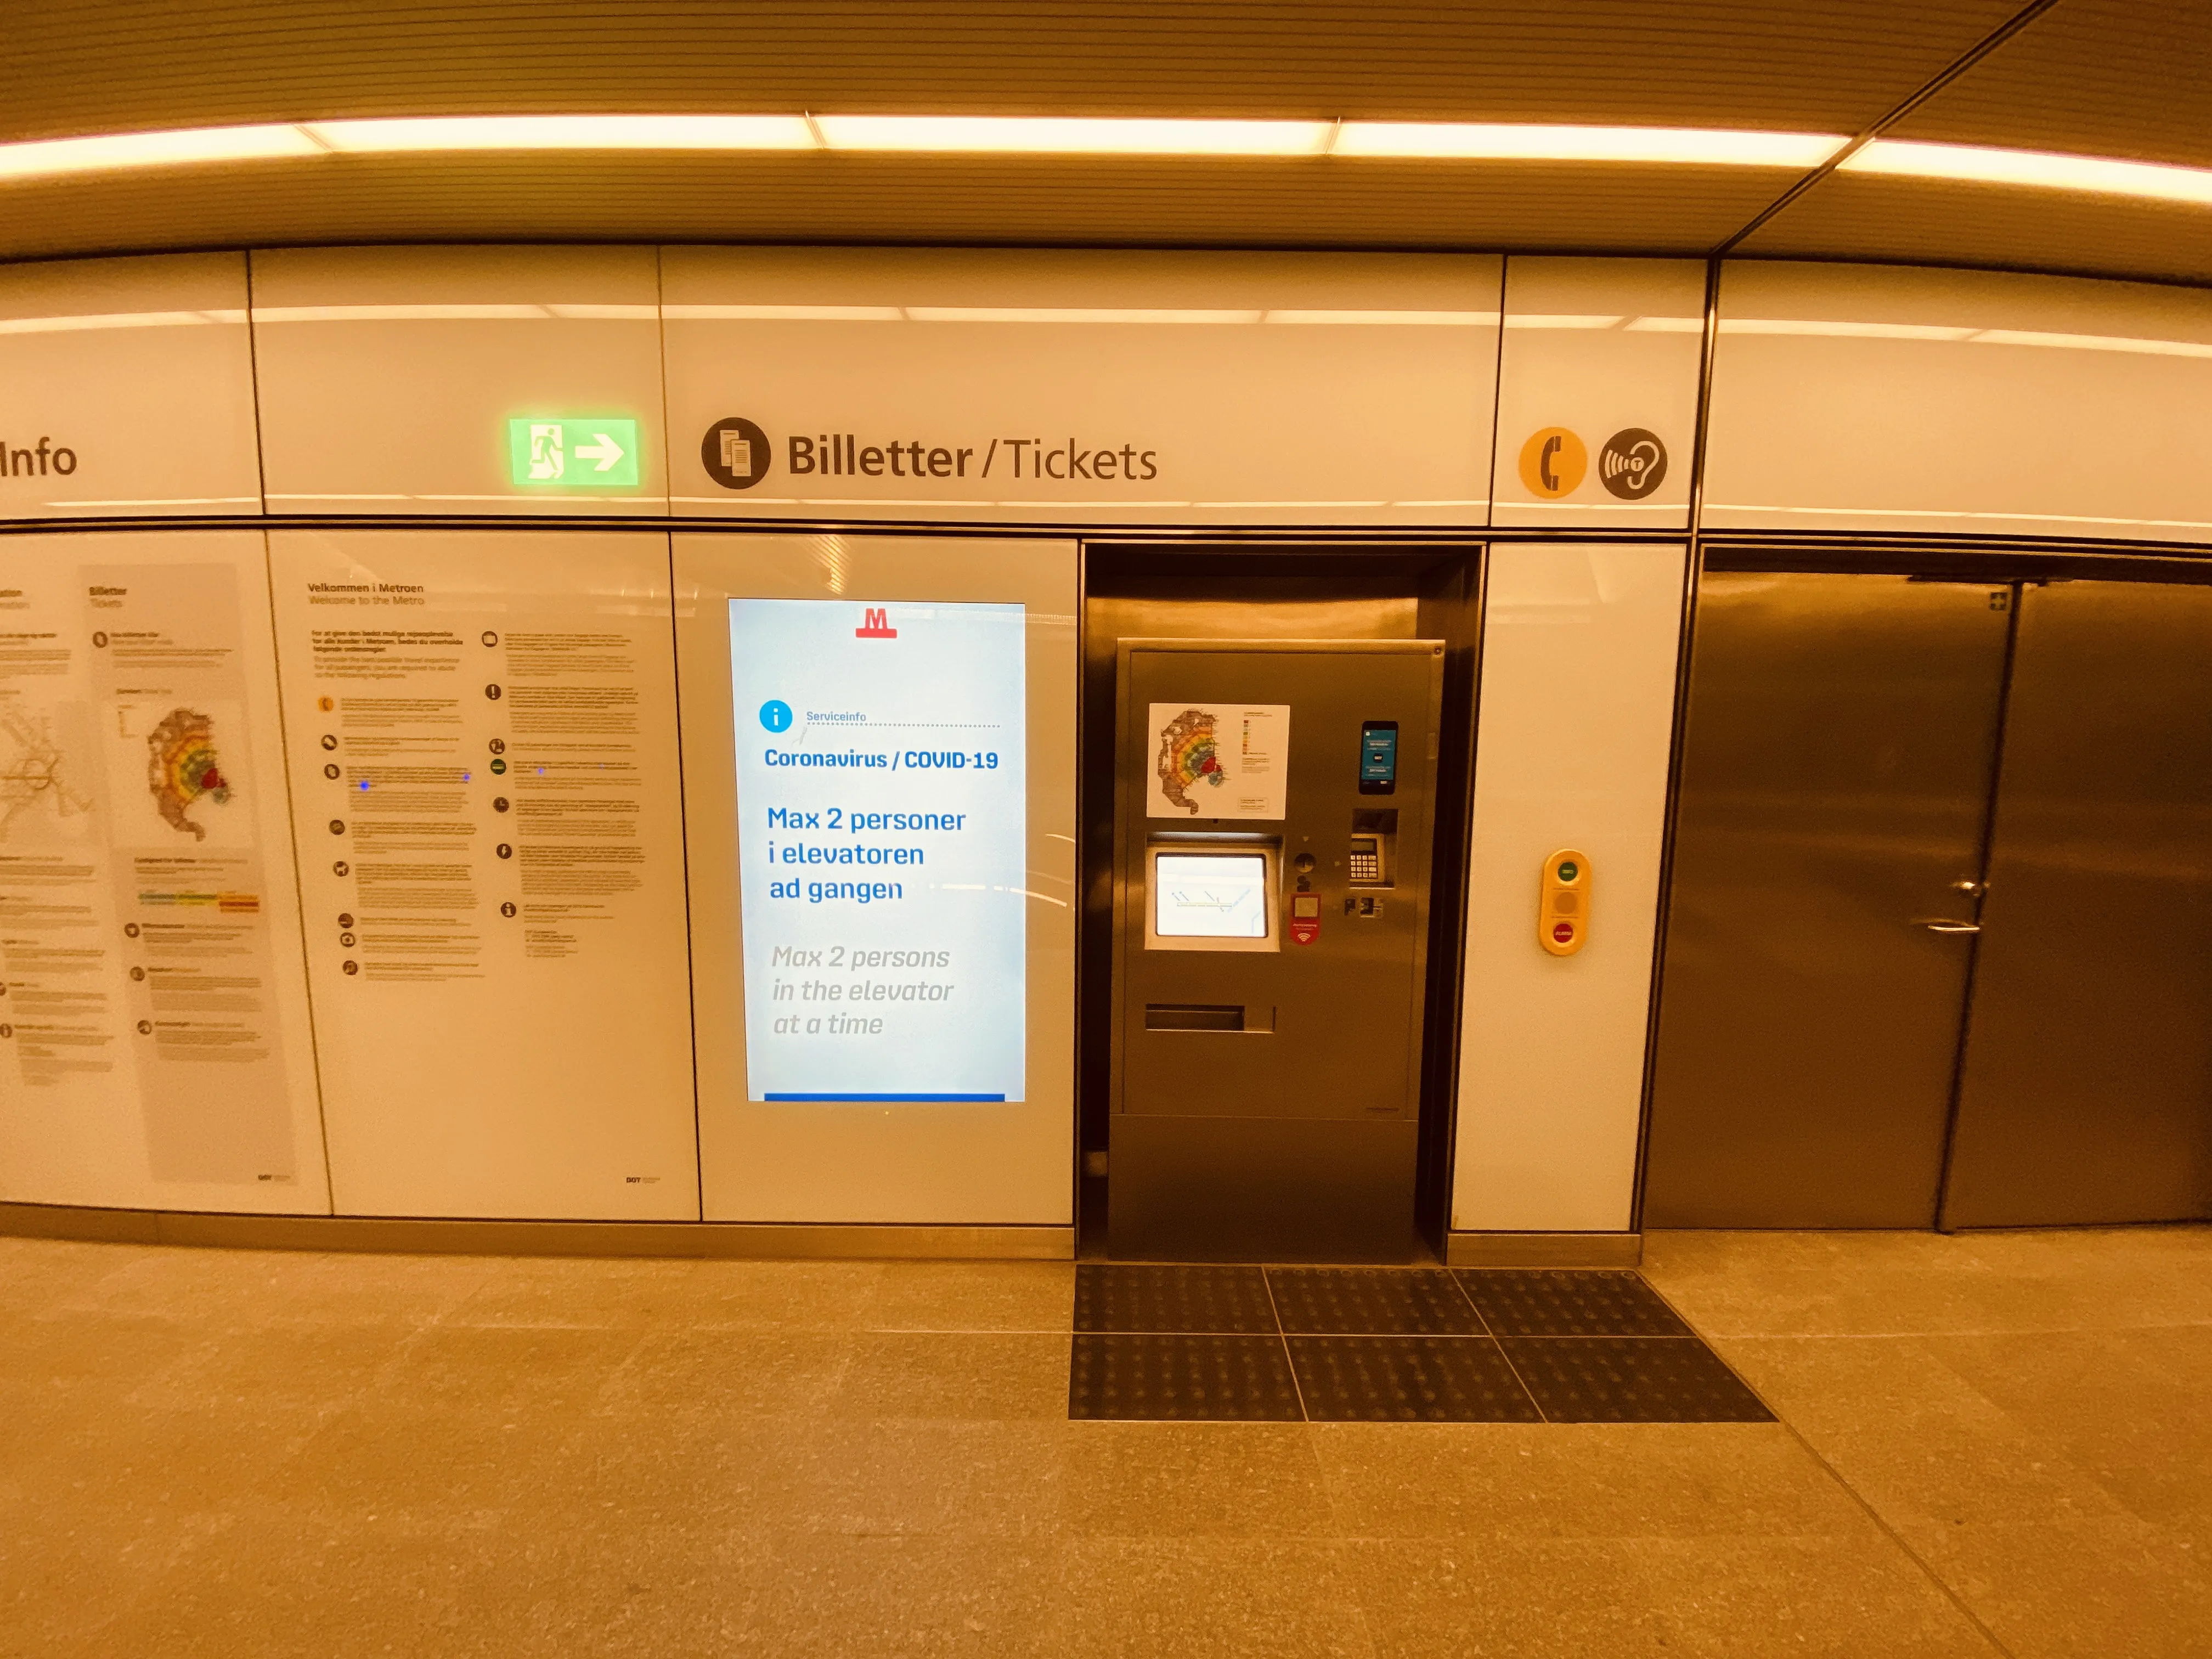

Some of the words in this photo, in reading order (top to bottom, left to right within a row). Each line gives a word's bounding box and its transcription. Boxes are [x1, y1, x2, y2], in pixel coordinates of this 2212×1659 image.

[0, 437, 77, 477] Info
[789, 434, 973, 477] Billetter
[1003, 438, 1157, 480] Tickets
[308, 583, 369, 592] Velkommen
[373, 583, 375, 592] i
[379, 584, 424, 592] Metroen
[393, 596, 425, 605] Metro
[806, 711, 866, 721] Serviceinfo
[765, 749, 887, 768] Coronavirus
[905, 751, 998, 769] COVID-19
[768, 808, 820, 829] Max
[827, 808, 843, 830] 2
[851, 812, 966, 833] personer
[769, 840, 774, 863] i
[782, 843, 924, 865] elevatoren
[770, 878, 800, 898] ad
[808, 882, 902, 904] gangen
[771, 946, 822, 967] Max
[828, 946, 845, 967] 2
[851, 950, 950, 971] persons
[773, 978, 794, 1001] in
[802, 980, 842, 1001] the
[849, 980, 955, 1001] elevator
[774, 1014, 800, 1034] at
[806, 1018, 821, 1034] a
[828, 1012, 883, 1034] time
